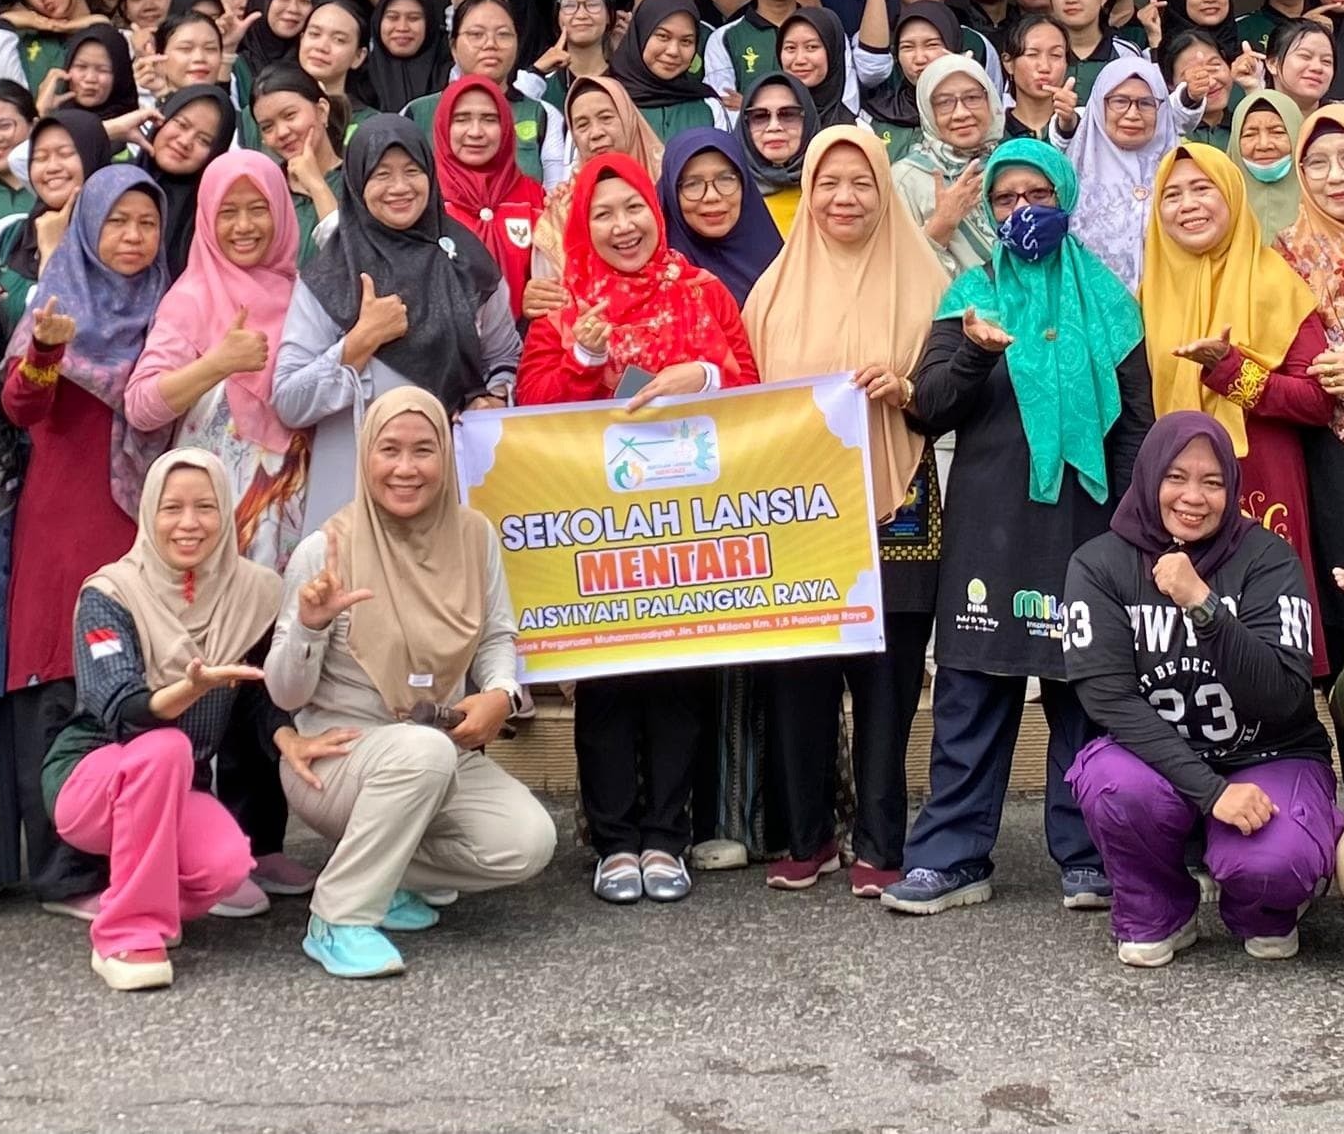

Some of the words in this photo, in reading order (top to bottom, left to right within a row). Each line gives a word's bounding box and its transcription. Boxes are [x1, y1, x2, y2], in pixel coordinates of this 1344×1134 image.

[500, 500, 682, 551] SEKOLAH
[690, 483, 840, 534] LANSIA
[576, 534, 771, 596] MENTARI
[518, 599, 629, 631] AISYIYAH
[635, 585, 769, 621] PALANGKA
[774, 578, 840, 606] RAYA
[1154, 661, 1177, 680] BE
[1148, 682, 1239, 742] 23
